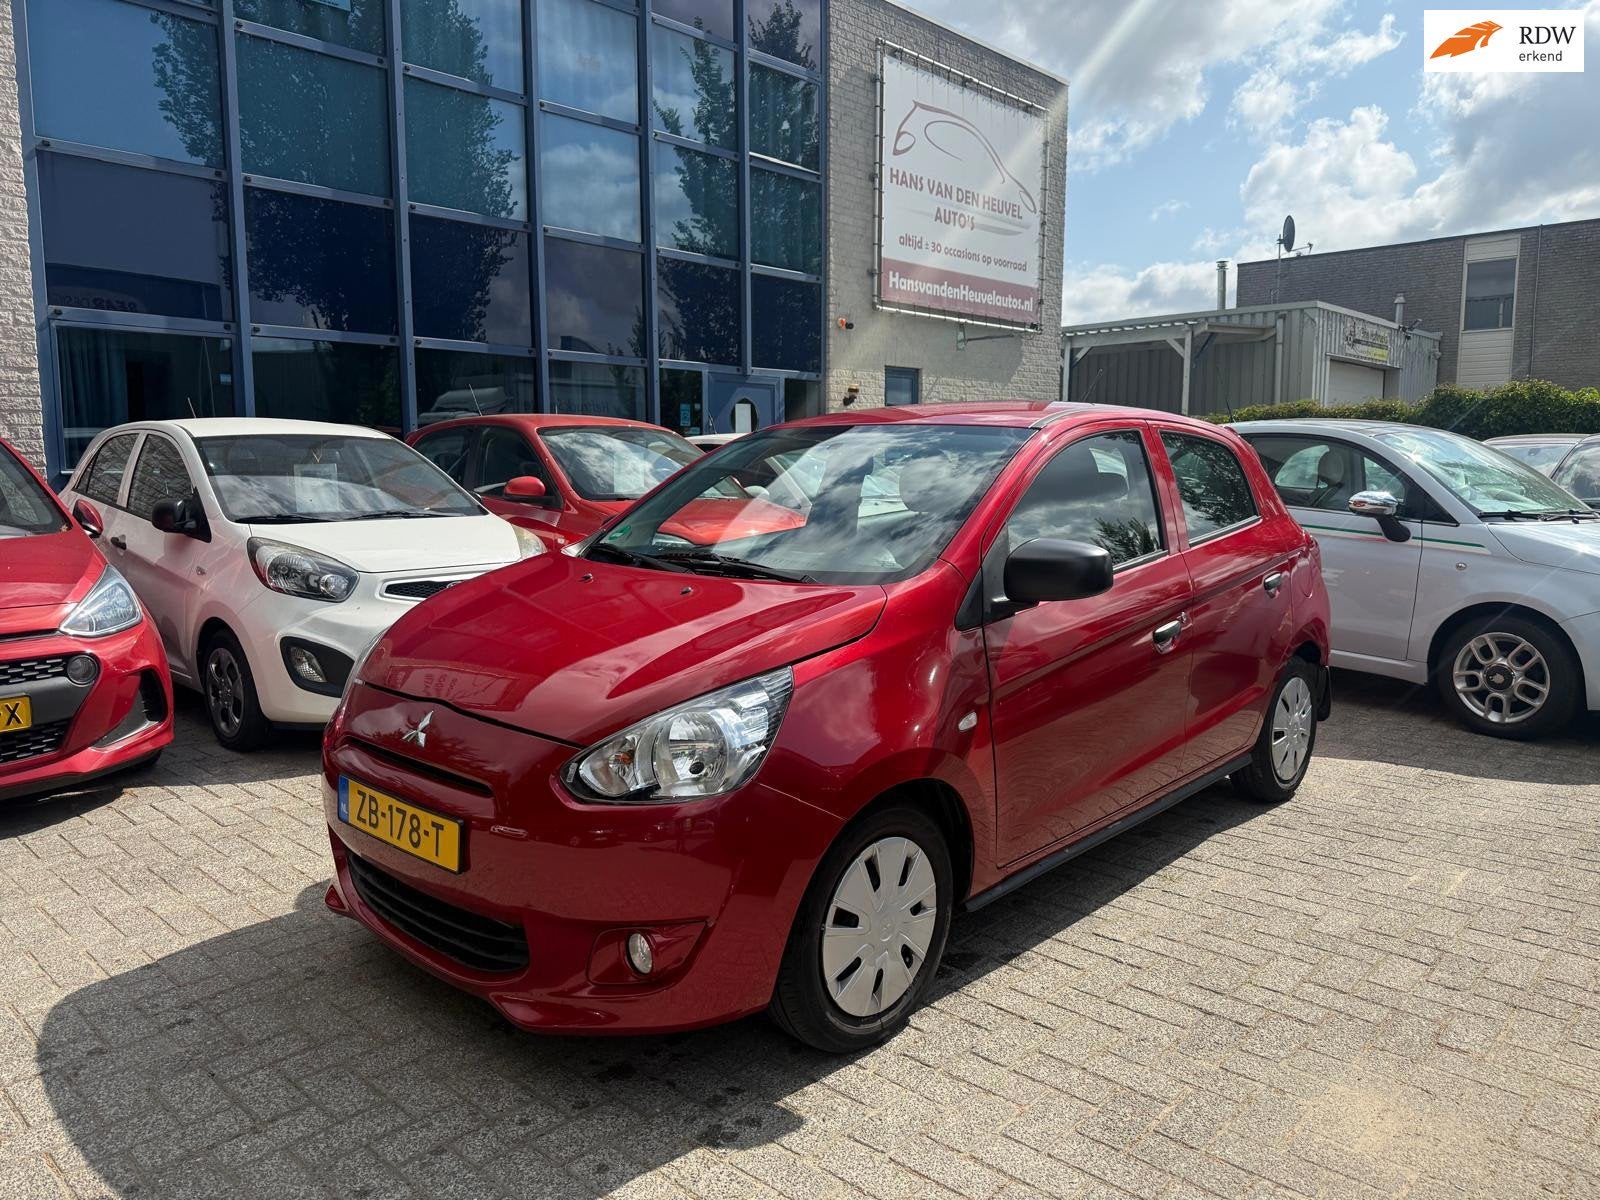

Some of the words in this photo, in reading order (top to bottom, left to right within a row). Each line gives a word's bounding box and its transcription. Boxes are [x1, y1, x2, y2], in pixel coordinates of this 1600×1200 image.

[889, 167, 924, 193] HANS
[927, 178, 953, 201] VAN
[956, 186, 980, 208] DEN
[982, 194, 1023, 220] HEUVEL
[934, 206, 976, 232] AUTO'S
[898, 233, 923, 250] altijd
[931, 241, 942, 254] 30
[943, 246, 980, 263] occasions
[981, 254, 992, 266] op
[993, 257, 1028, 272] voorraad
[888, 270, 1034, 312] HansvandenHeuvelautos.nl
[0, 702, 23, 727] X
[356, 789, 445, 858] ZB-178-T
